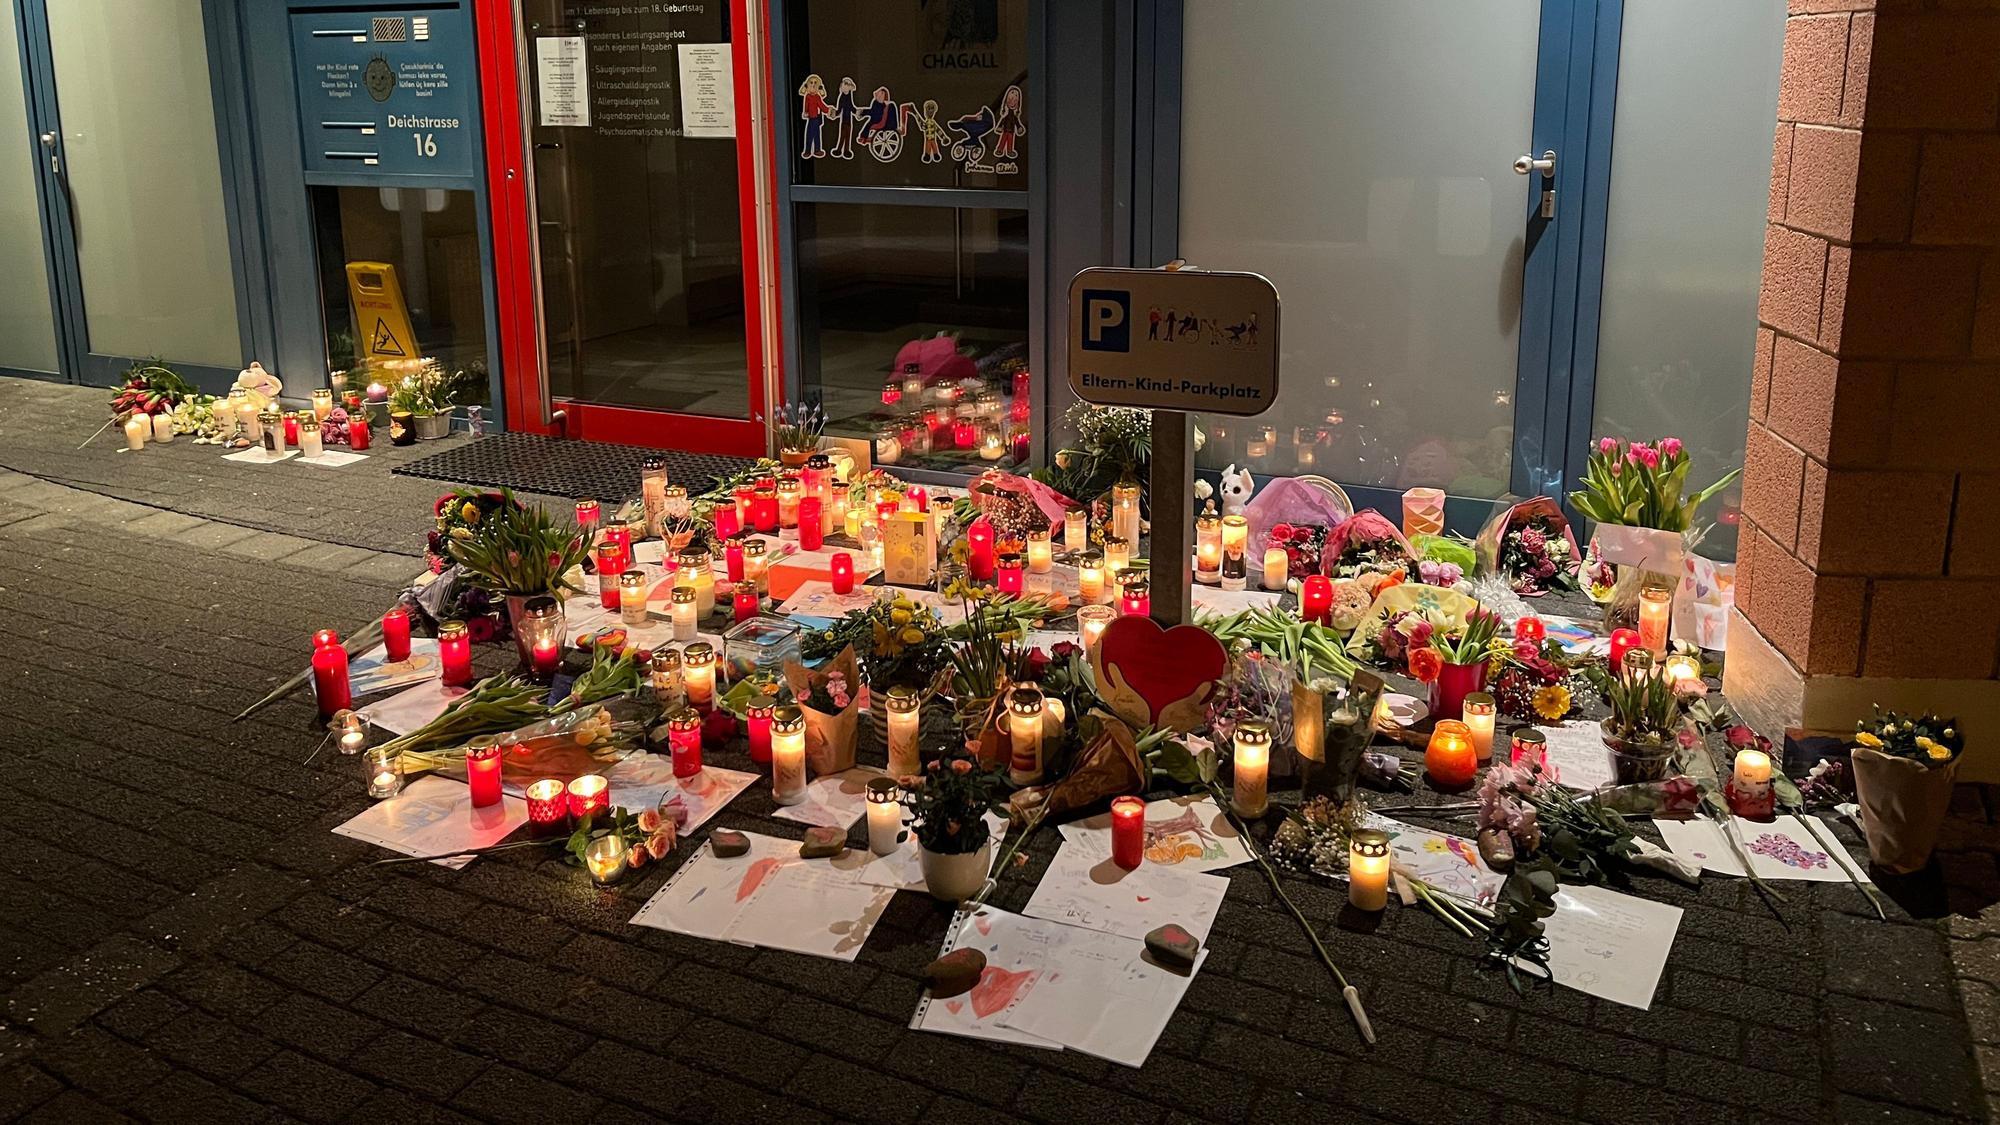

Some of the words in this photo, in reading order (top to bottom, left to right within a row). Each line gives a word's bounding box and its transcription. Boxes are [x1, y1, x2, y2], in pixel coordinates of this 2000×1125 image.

[584, 6, 620, 16] Lebenstag
[621, 6, 632, 14] bis
[651, 4, 661, 13] 18.
[663, 3, 704, 14] Geburtstag
[580, 31, 620, 40] Besonderes
[622, 30, 686, 40] Leistungsangebot
[593, 43, 610, 52] nach
[612, 43, 640, 53] eigenen
[641, 41, 673, 53] Angaben
[922, 53, 999, 70] CHAGALL
[596, 81, 671, 91] Ultraschalldiagnostik
[597, 97, 660, 107] Allergiediagnostik
[388, 114, 460, 129] Deichstrasse
[598, 112, 671, 122] Jugendsprechstunde
[599, 126, 664, 137] Psychosomatische
[413, 133, 438, 157] 16
[1089, 299, 1124, 342] P
[1082, 373, 1261, 400] Eltern-Kind-Parkplatz
